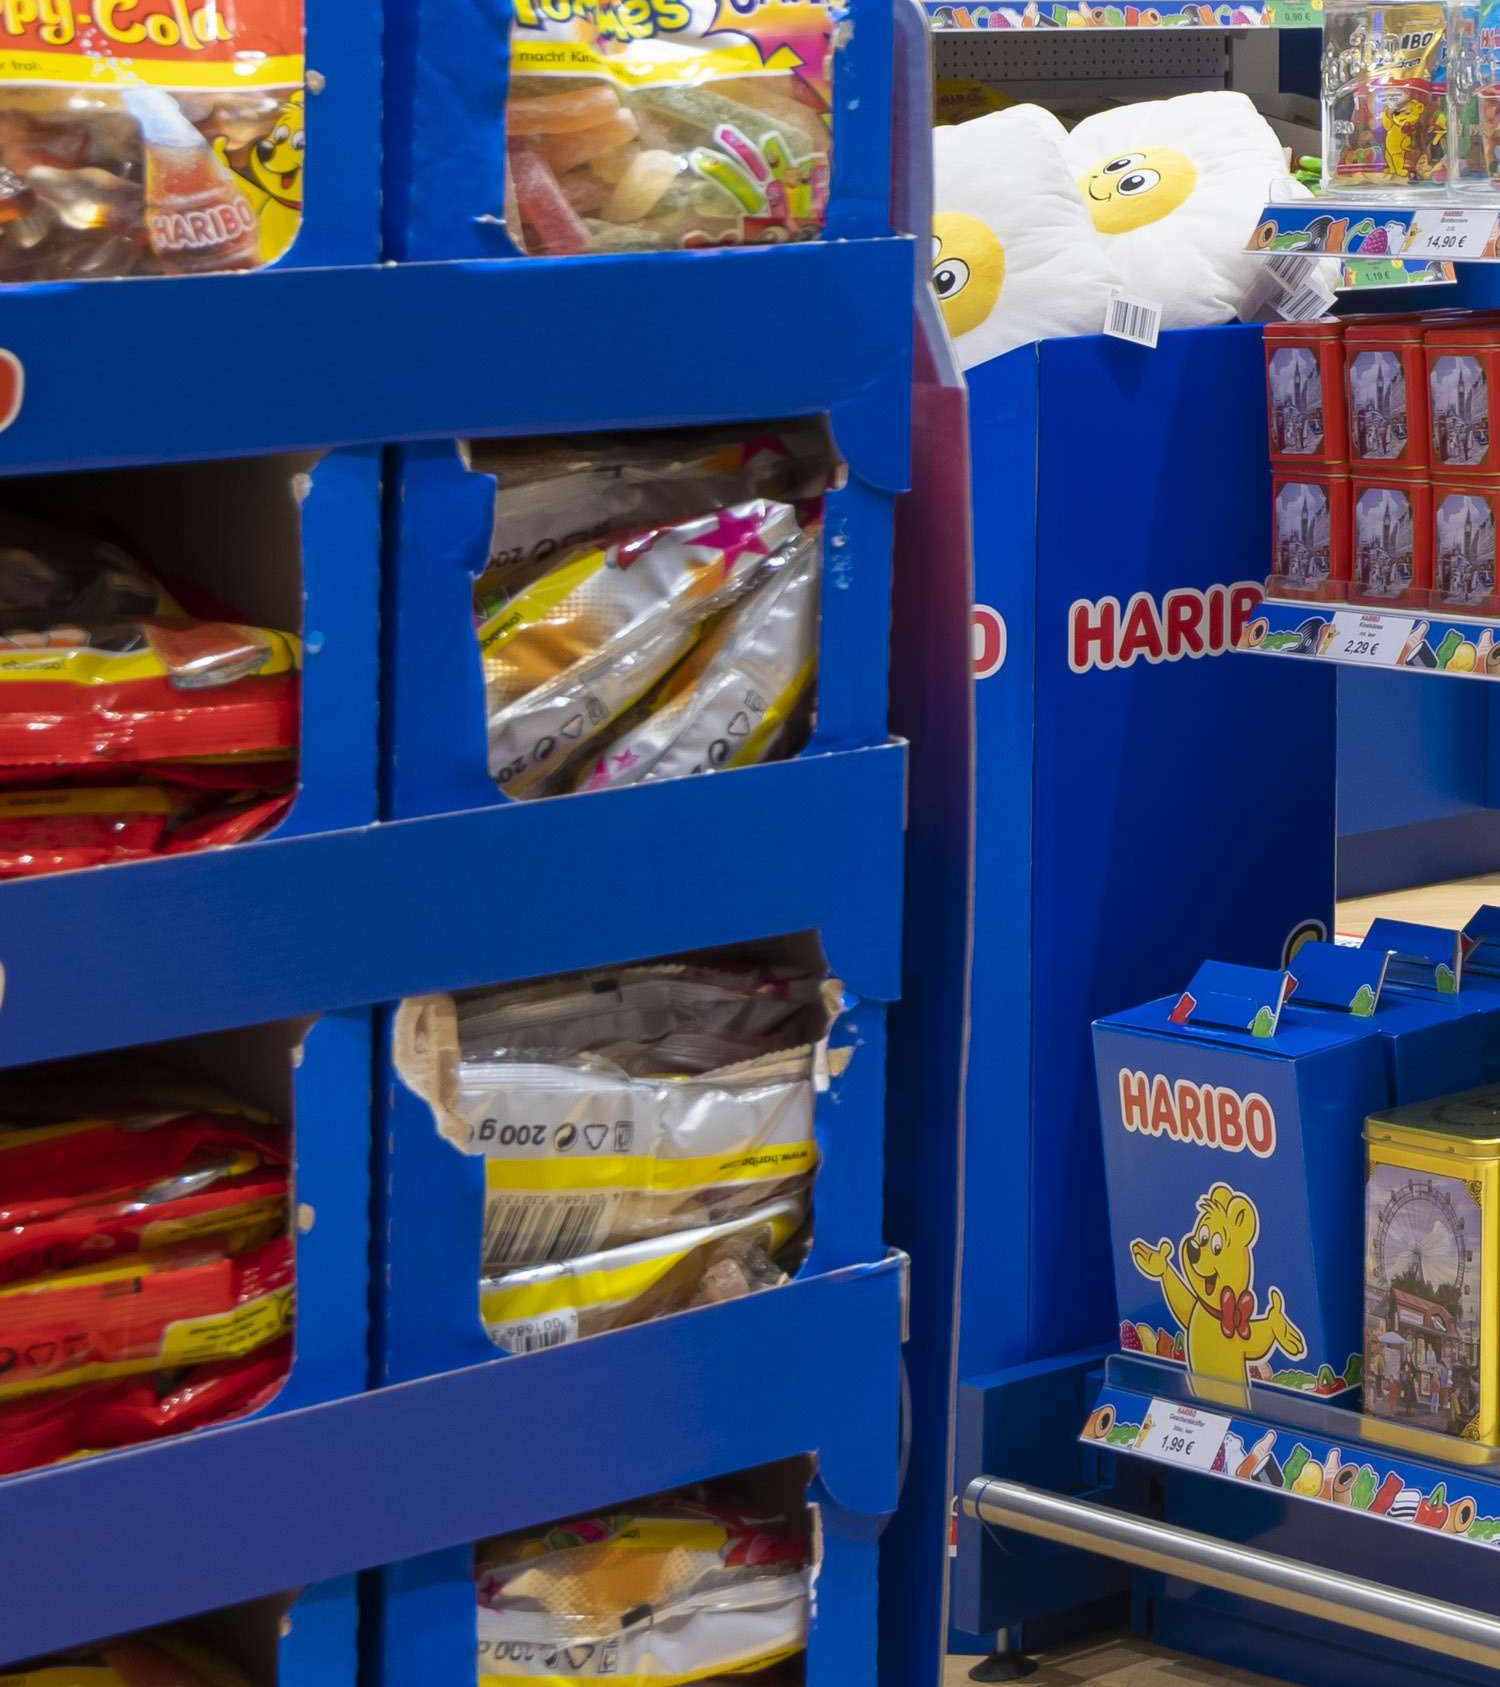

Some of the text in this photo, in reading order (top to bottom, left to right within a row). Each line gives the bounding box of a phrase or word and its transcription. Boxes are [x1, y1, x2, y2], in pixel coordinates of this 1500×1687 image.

[152, 200, 252, 249] HARIBO
[1426, 235, 1467, 248] 14,90 €
[1070, 584, 1262, 672] HARIB
[1344, 640, 1380, 655] 2,29 €
[1121, 1067, 1275, 1157] HARIBO
[500, 1123, 547, 1146] 200
[1161, 1434, 1195, 1455] 1,99 €
